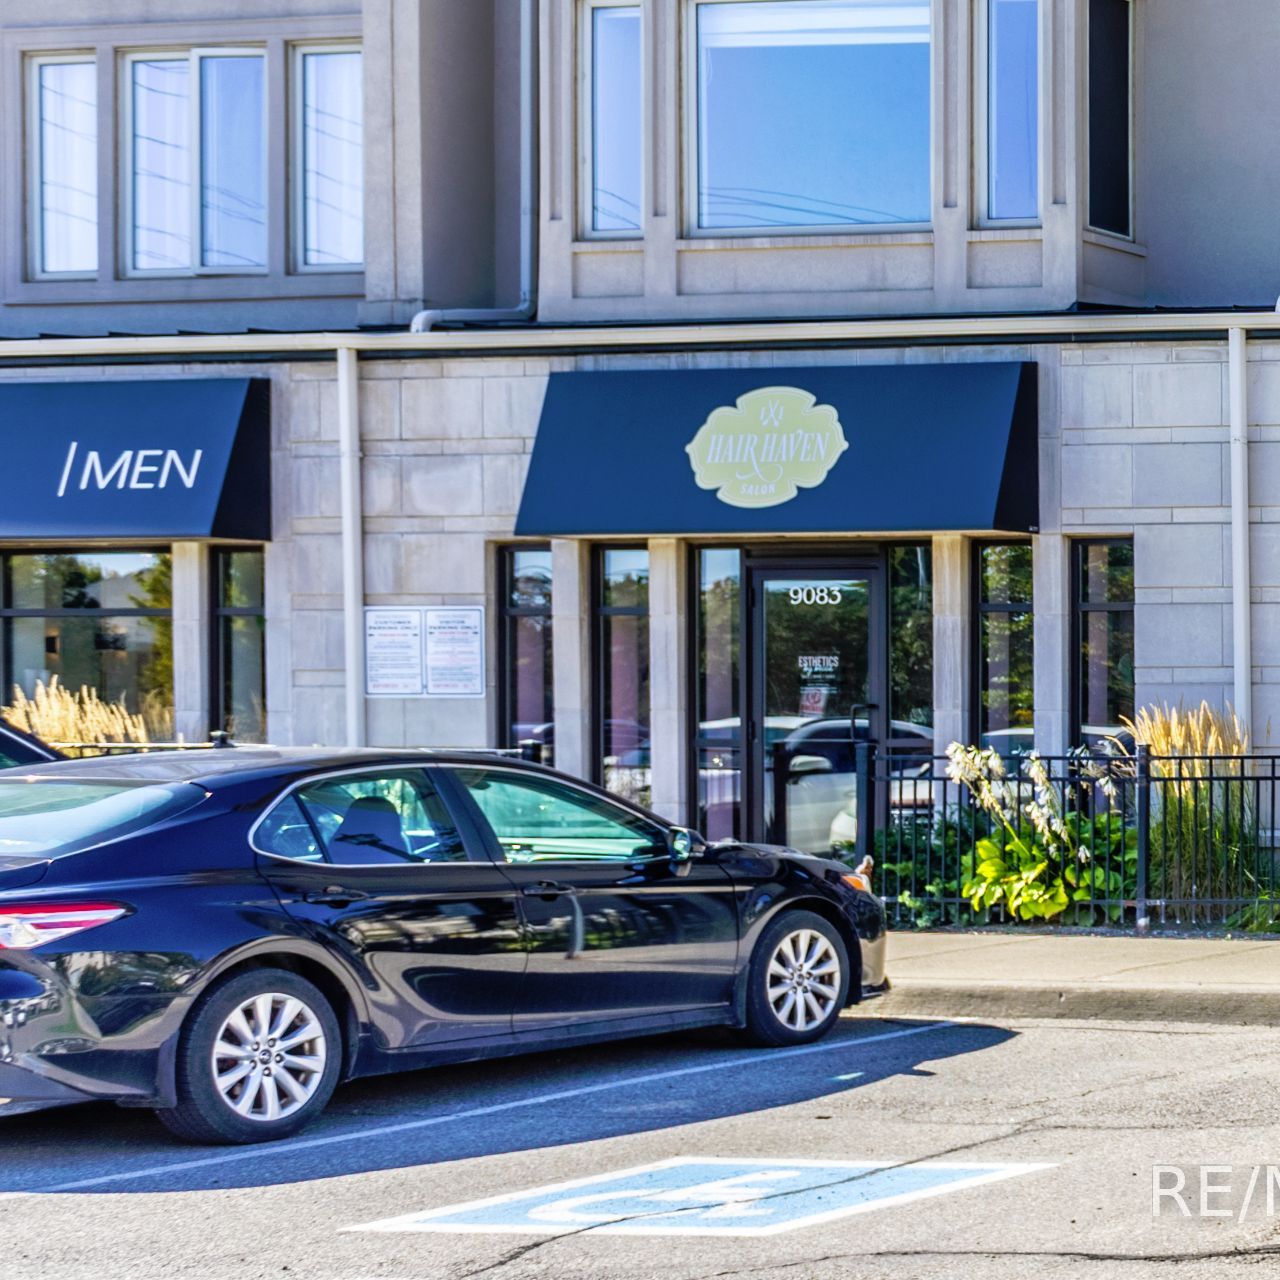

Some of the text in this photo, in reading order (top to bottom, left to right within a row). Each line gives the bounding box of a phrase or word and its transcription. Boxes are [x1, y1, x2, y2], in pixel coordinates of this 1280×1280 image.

[706, 428, 830, 482] HAIR HAVEN
[740, 483, 776, 496] SALON
[789, 586, 842, 605] 9083
[798, 655, 840, 668] ESTHETICS
